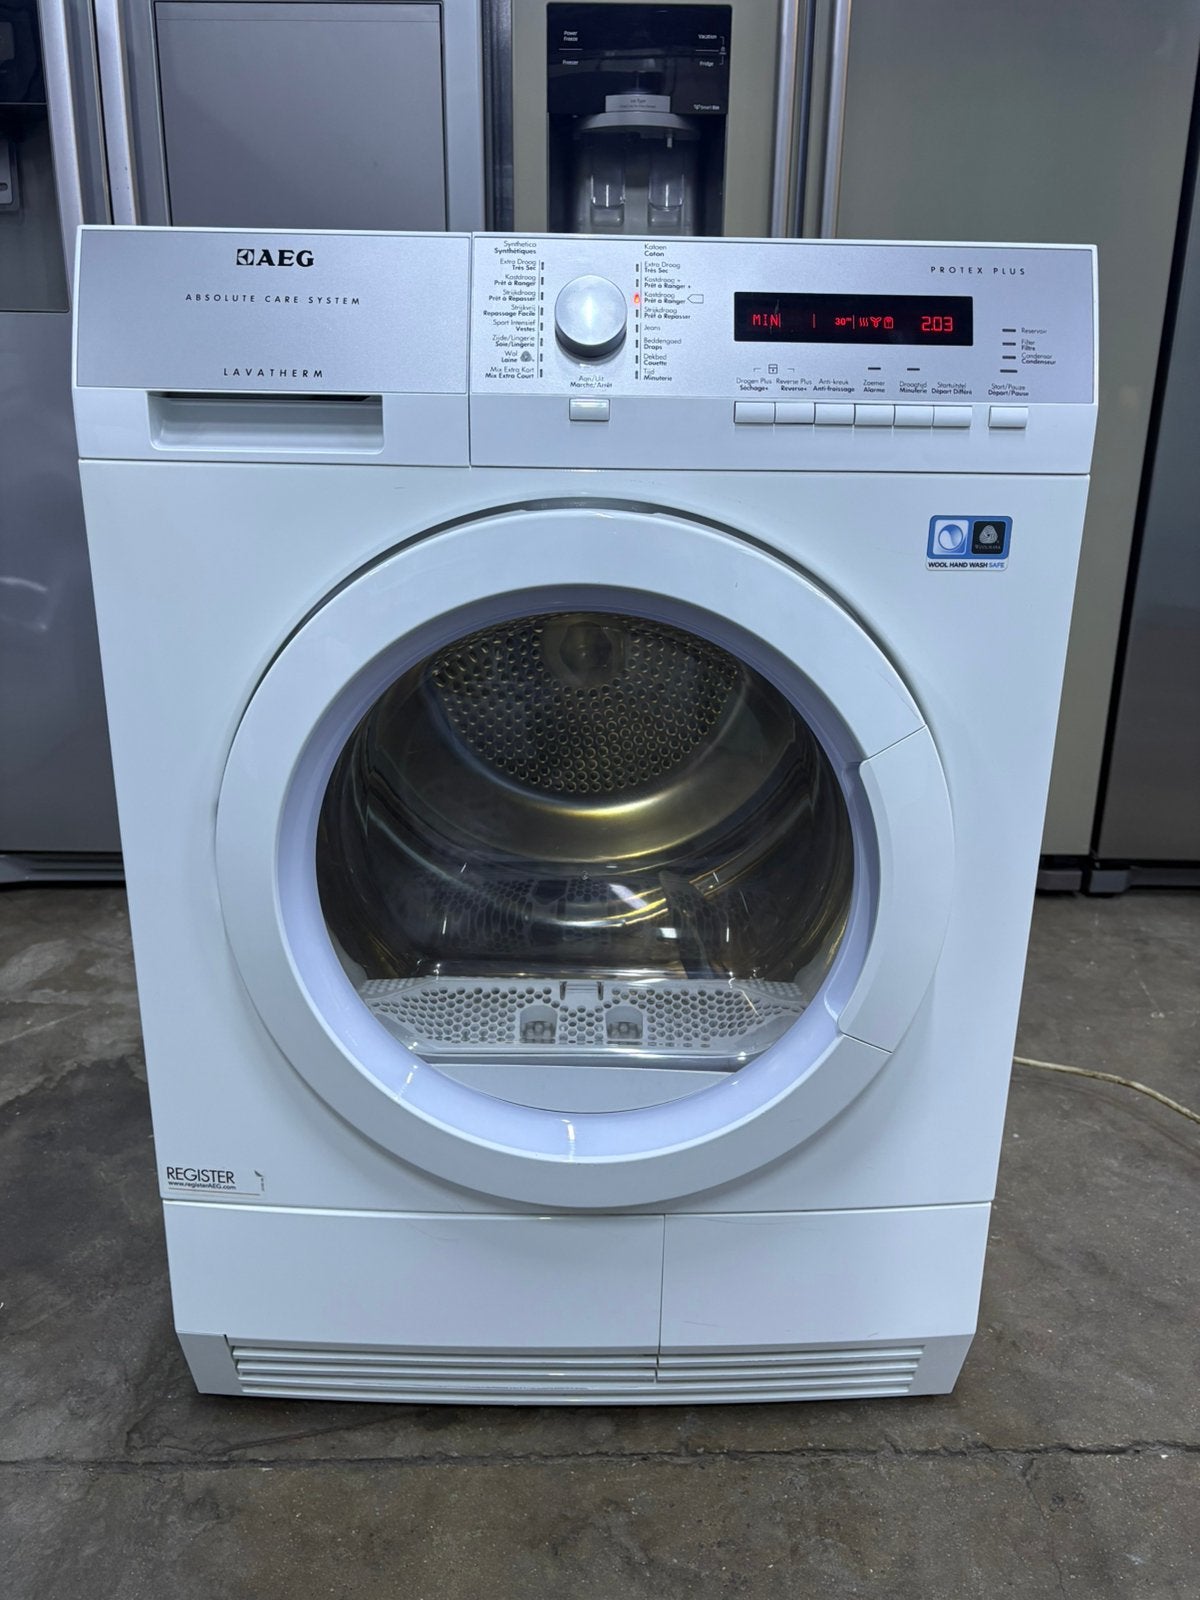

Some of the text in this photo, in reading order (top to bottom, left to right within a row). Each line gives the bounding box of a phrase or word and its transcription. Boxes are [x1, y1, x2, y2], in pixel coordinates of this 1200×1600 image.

[504, 240, 536, 248] Synthetica
[256, 250, 314, 267] AEG
[661, 262, 680, 270] Droog
[930, 266, 1026, 275] PROTEX PLUS
[505, 274, 536, 282] Kastdroog
[664, 282, 686, 290] Ranger
[185, 294, 360, 305] ABSOLUTE CARE SYSTEM
[493, 319, 509, 327] Sport
[752, 314, 779, 327] MIN
[920, 316, 954, 332] 2.03
[223, 368, 323, 378] LAVATHERM
[736, 377, 759, 386] Drogen
[988, 389, 1029, 397] Départ/Pause
[166, 1166, 235, 1184] REGISTER
[168, 1181, 236, 1190] www.registerAEG.com
